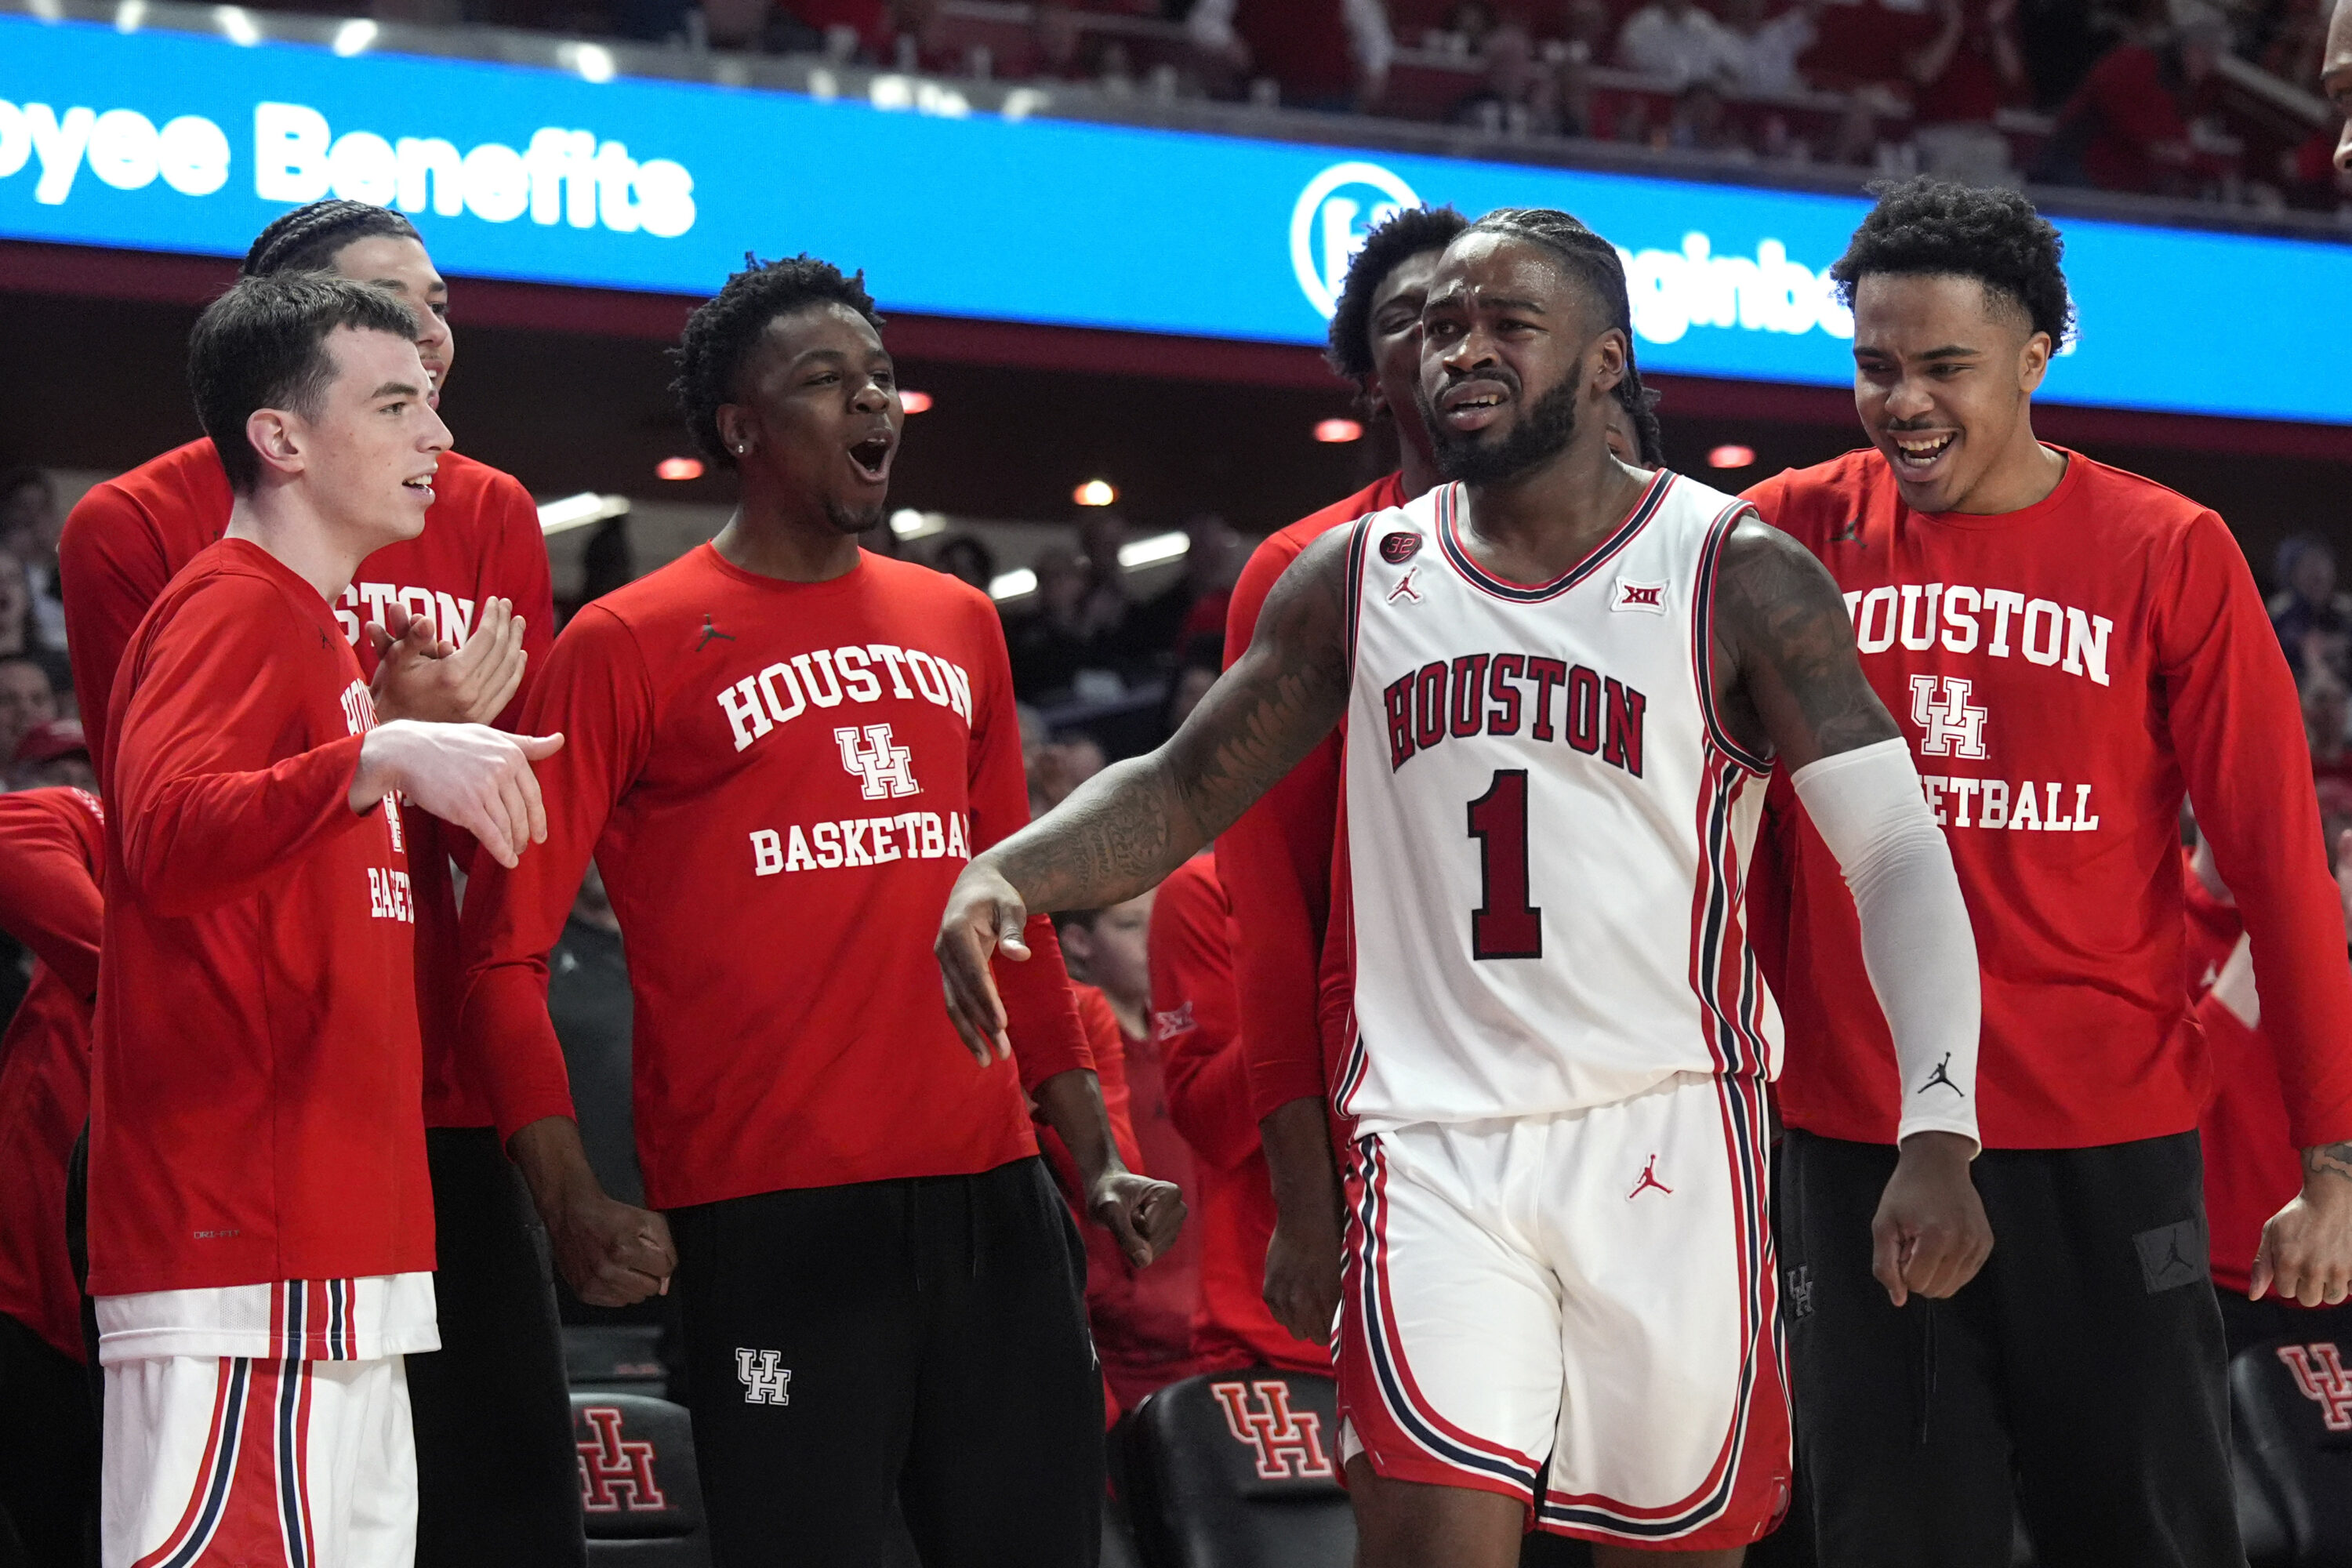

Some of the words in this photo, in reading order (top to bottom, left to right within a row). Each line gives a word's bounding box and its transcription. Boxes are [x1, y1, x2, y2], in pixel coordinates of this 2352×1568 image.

[253, 101, 696, 238] Benefits
[1386, 536, 1416, 554] 32
[1621, 585, 1661, 606] XII
[717, 644, 972, 753] HOUSTON
[1384, 653, 1646, 779] HOUSTON
[1918, 775, 2100, 831] ETBALL
[1467, 768, 1542, 960] 1
[735, 1348, 792, 1406] UH
